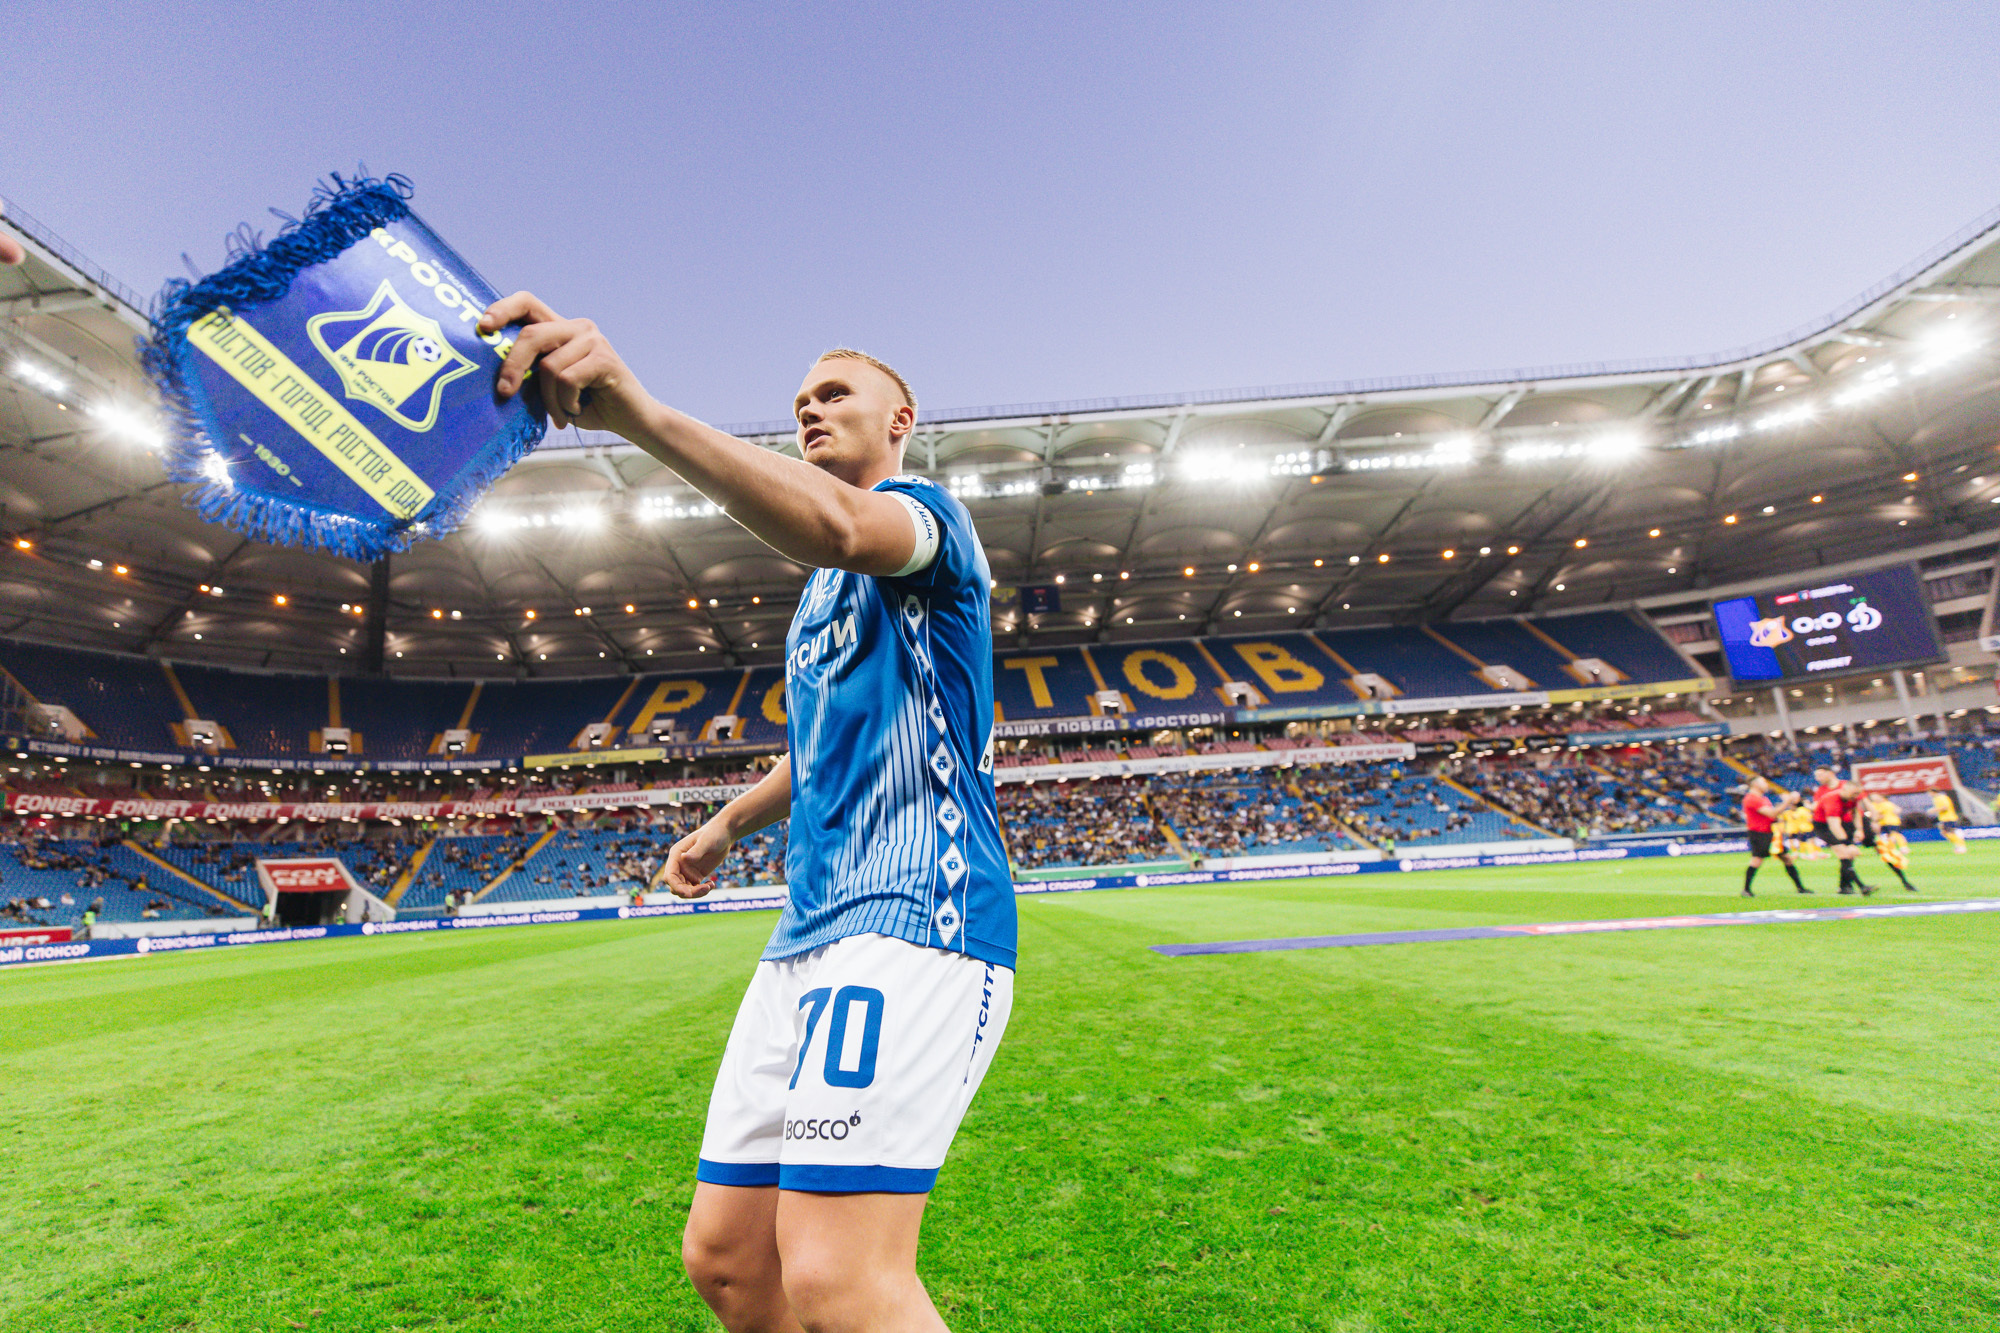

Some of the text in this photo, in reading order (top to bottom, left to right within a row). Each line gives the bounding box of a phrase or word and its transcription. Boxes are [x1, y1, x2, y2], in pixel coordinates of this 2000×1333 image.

[357, 370, 396, 406] РОСТОВ
[994, 713, 1226, 737] НАШИХ ПОБЕД «РОСТОВ»!
[682, 787, 750, 801] РОССЕЛЬ
[15, 794, 99, 814] FONBET
[110, 800, 192, 817] FONBET
[203, 804, 281, 818] FONBET
[292, 803, 365, 818] FONBET
[376, 803, 443, 817] FONBET
[453, 801, 514, 815] FONBET
[25, 944, 91, 961] СПОНСОР
[788, 985, 885, 1091] 70
[785, 1119, 850, 1141] BOSCO
